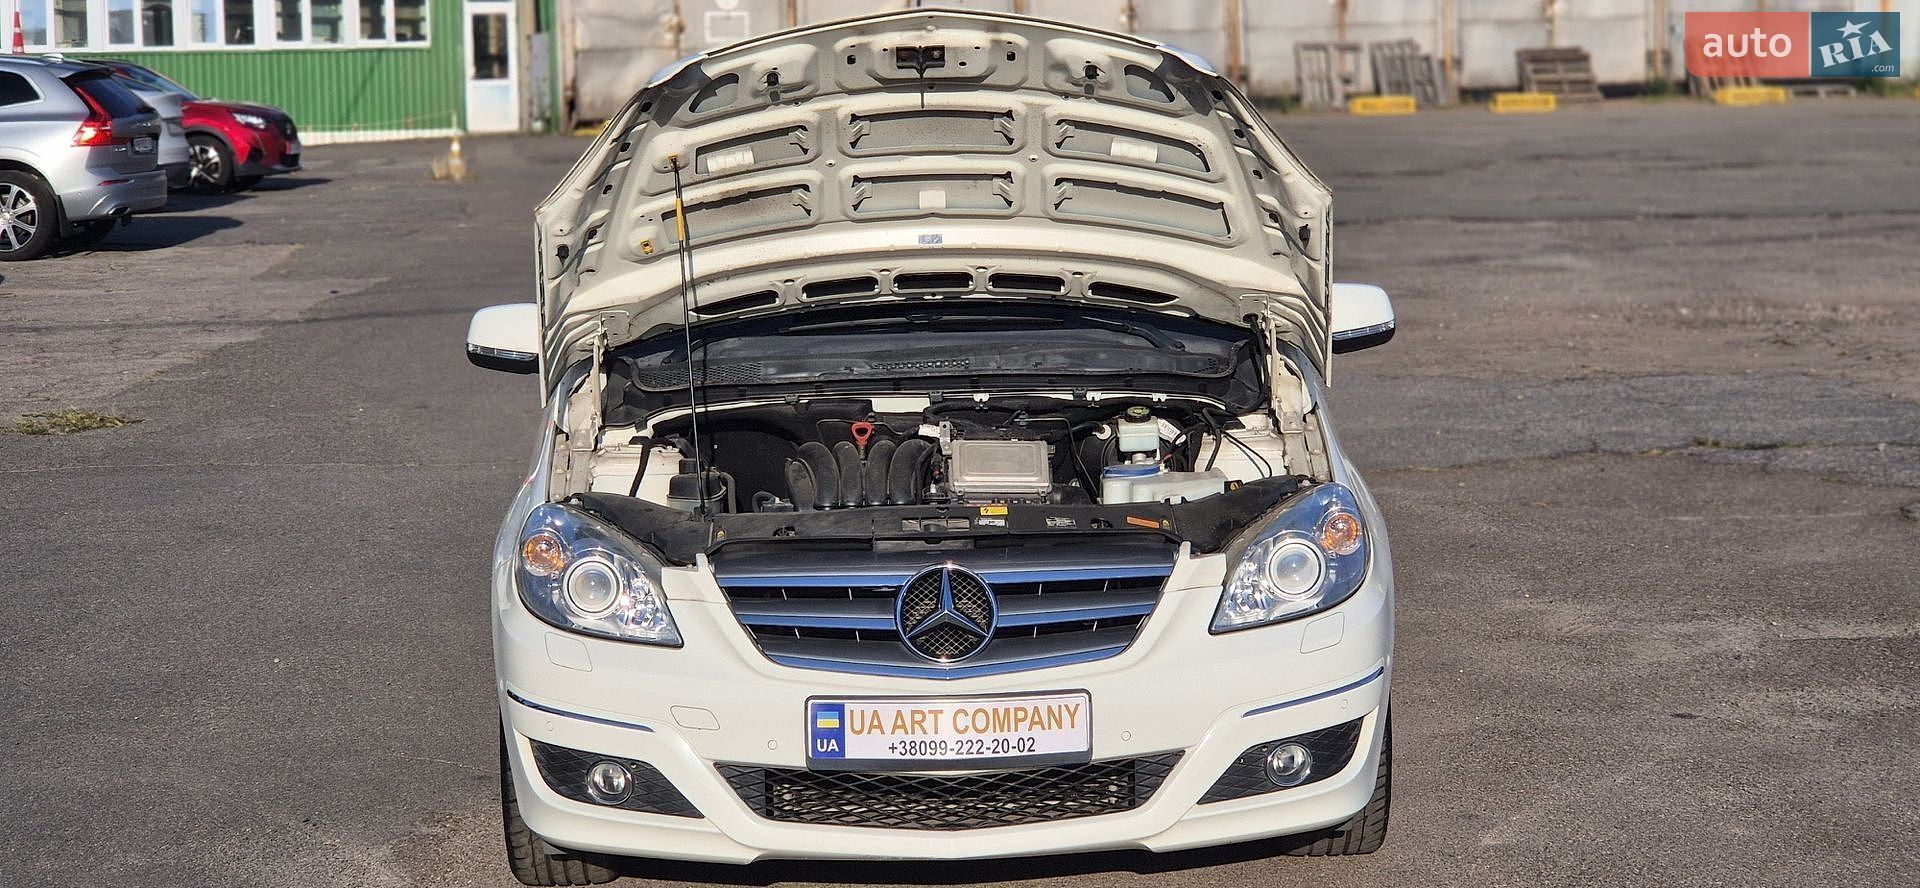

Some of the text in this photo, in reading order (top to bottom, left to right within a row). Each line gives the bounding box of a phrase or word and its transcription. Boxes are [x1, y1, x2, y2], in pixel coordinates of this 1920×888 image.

[849, 703, 1080, 735] UA ART COMPANY
[817, 739, 839, 752] UA
[888, 737, 1036, 756] +38099-222-20-02
